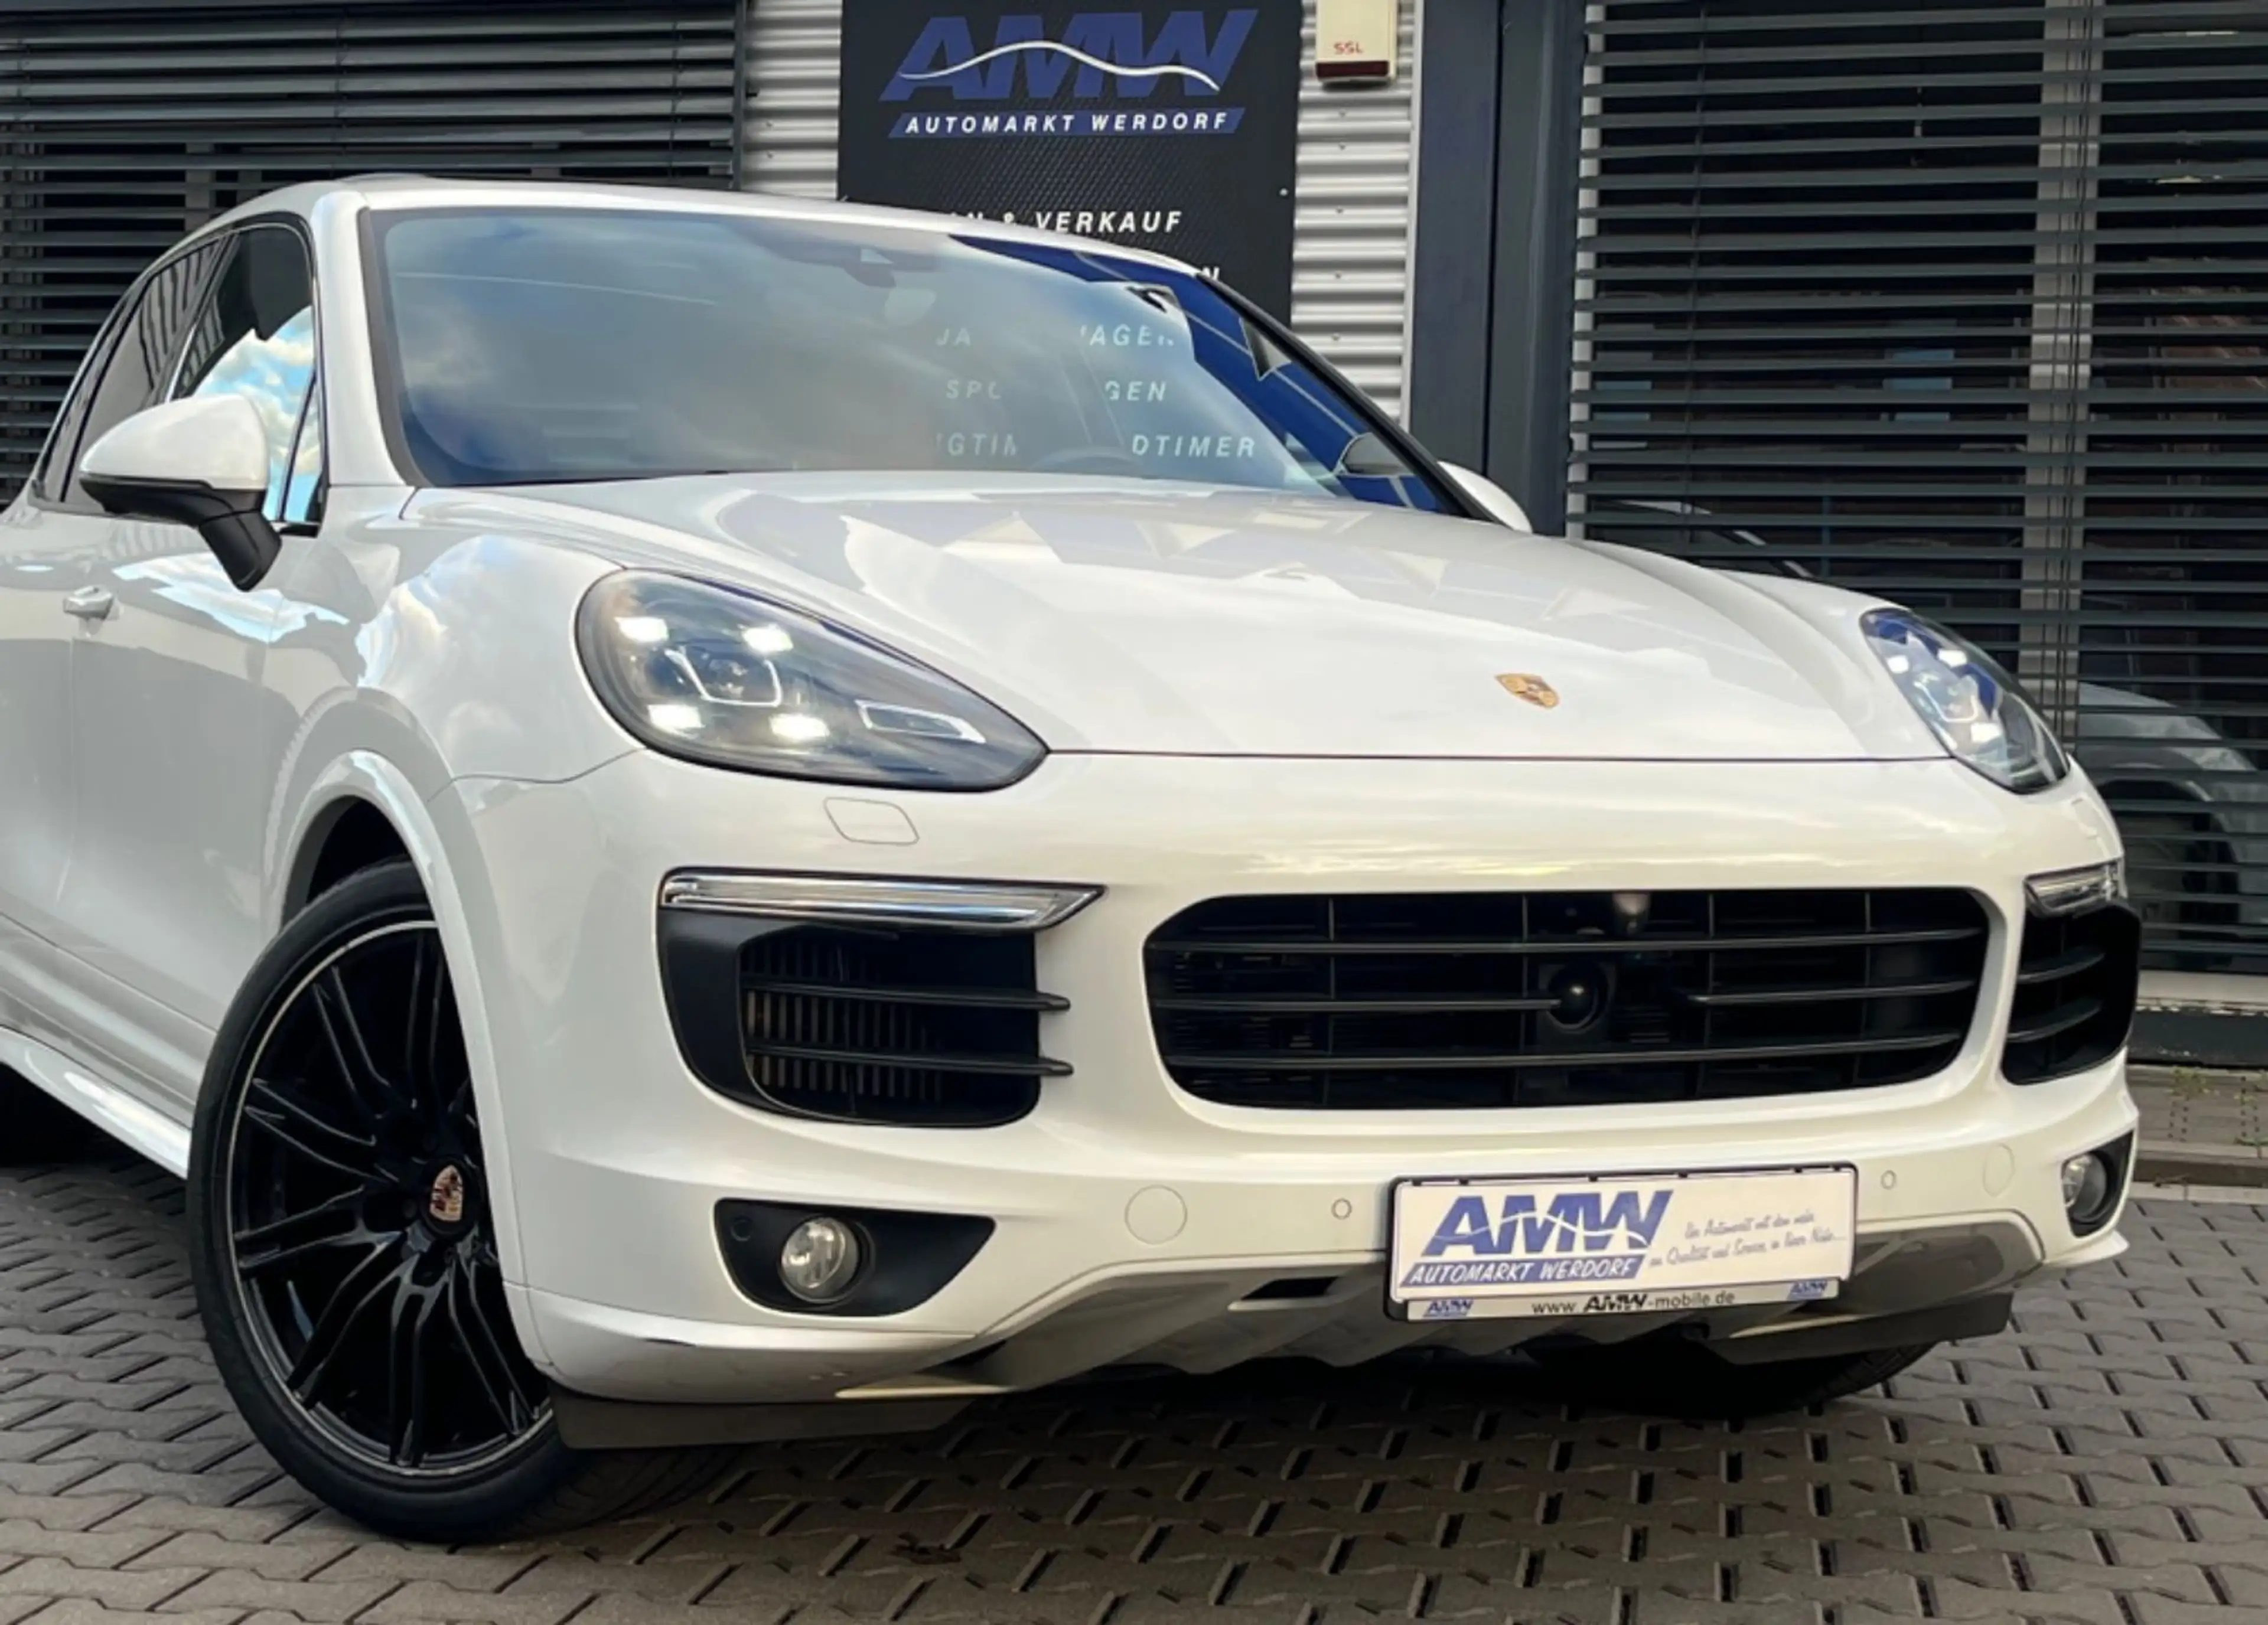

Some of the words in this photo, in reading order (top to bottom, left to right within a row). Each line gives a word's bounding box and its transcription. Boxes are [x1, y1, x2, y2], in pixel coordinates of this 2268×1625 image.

[879, 9, 1259, 101] AMW
[905, 115, 1075, 134] AUTOMARKT
[1091, 112, 1228, 132] WERDORF
[1036, 211, 1182, 233] VERKAUF
[1421, 1190, 1674, 1256] AMW
[1410, 1262, 1536, 1284] AUTOMARKT
[1540, 1256, 1635, 1282] WERDORF
